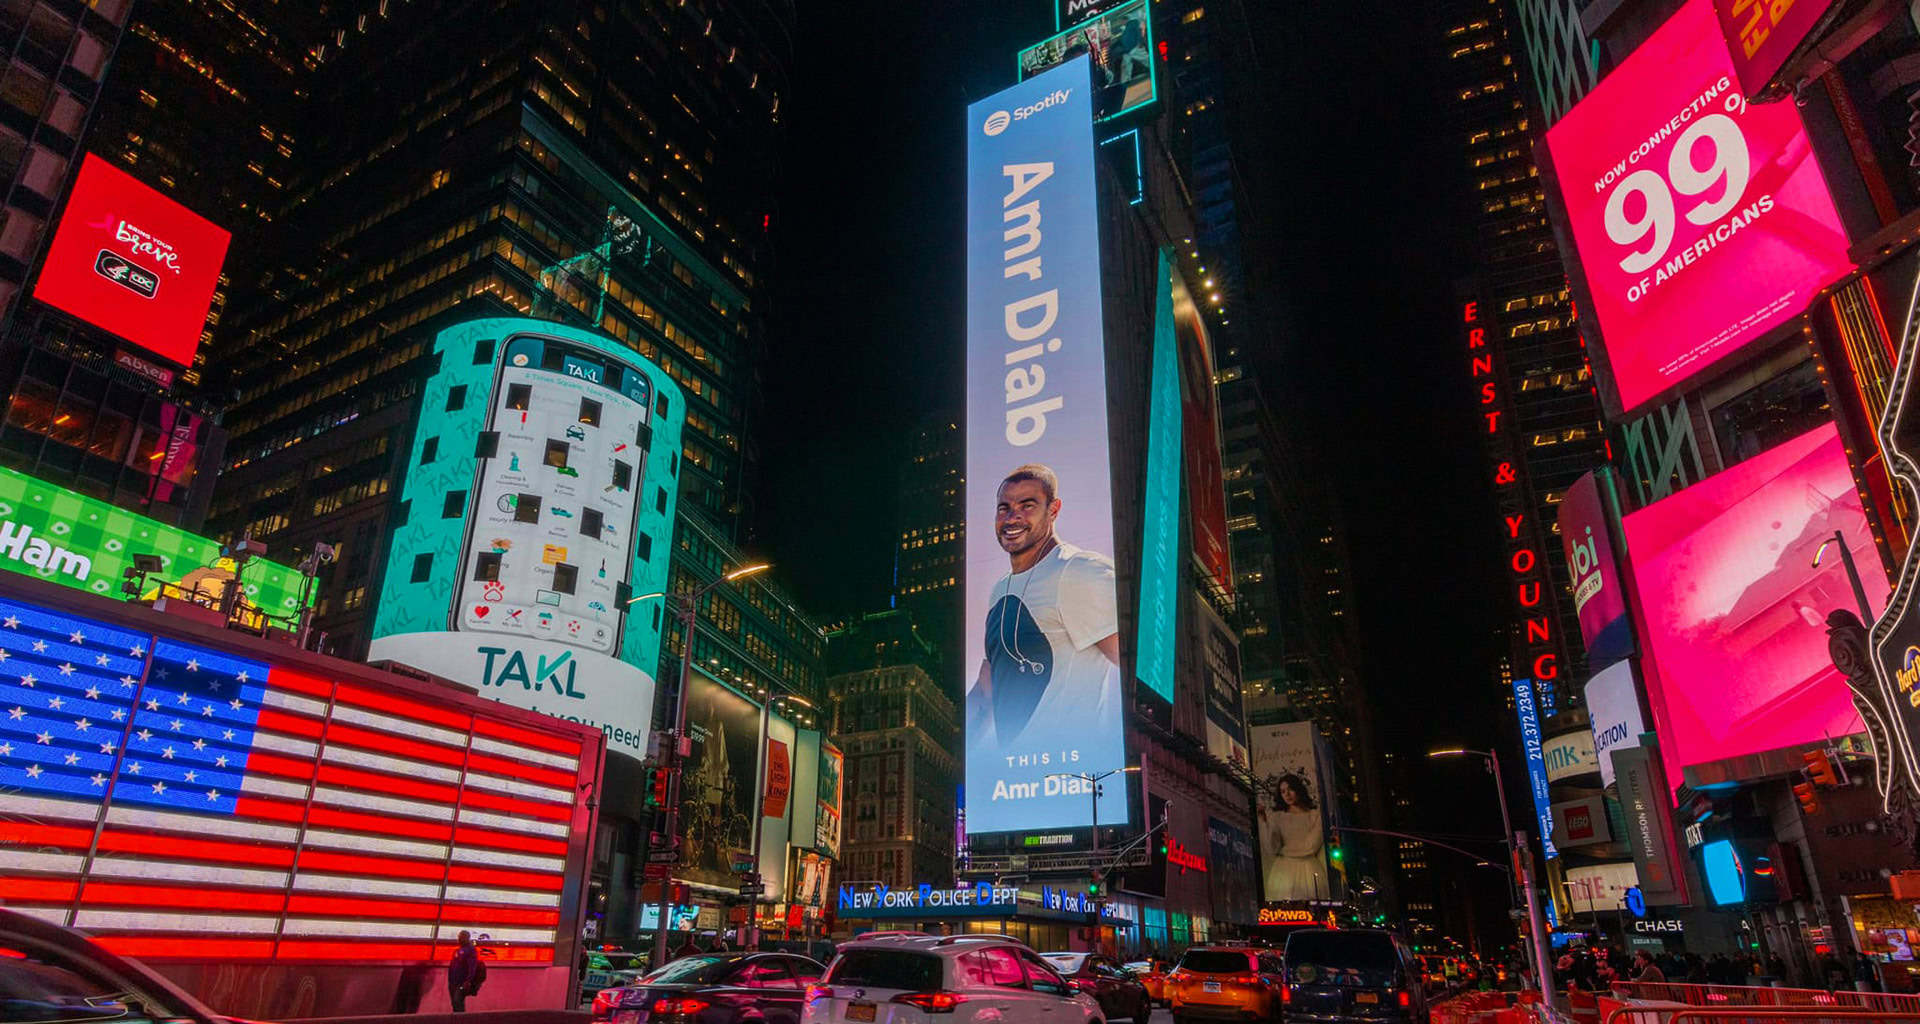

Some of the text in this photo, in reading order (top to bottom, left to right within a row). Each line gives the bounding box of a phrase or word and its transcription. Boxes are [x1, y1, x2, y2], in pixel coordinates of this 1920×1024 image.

[1013, 89, 1071, 121] Spotify
[1594, 76, 1731, 192] NOW CONNECTING
[153, 237, 173, 251] YOUR
[1627, 194, 1775, 302] OF AMERICANS
[1003, 162, 1063, 446] Amr Diab
[567, 362, 599, 384] TAKL
[1464, 301, 1558, 680] ERNST & YOUNG
[0, 520, 92, 581] Ham
[477, 646, 586, 700] TAKL
[1896, 659, 1919, 693] Hard
[1517, 684, 1543, 761] 212.372.2349
[603, 725, 641, 750] need
[773, 761, 784, 773] THE
[1006, 749, 1080, 768] THIS IS
[770, 771, 787, 783] LION
[992, 772, 1097, 801] Amr Diab
[768, 785, 787, 798] KING
[1568, 815, 1588, 829] LEGO
[1638, 812, 1654, 858] THOMSON
[839, 881, 1019, 909] NEW YORK POLICE DEPT
[1042, 885, 1060, 910] NEW
[1059, 888, 1079, 912] YORK
[1259, 907, 1313, 923] Subway
[1635, 920, 1683, 933] CHASE
